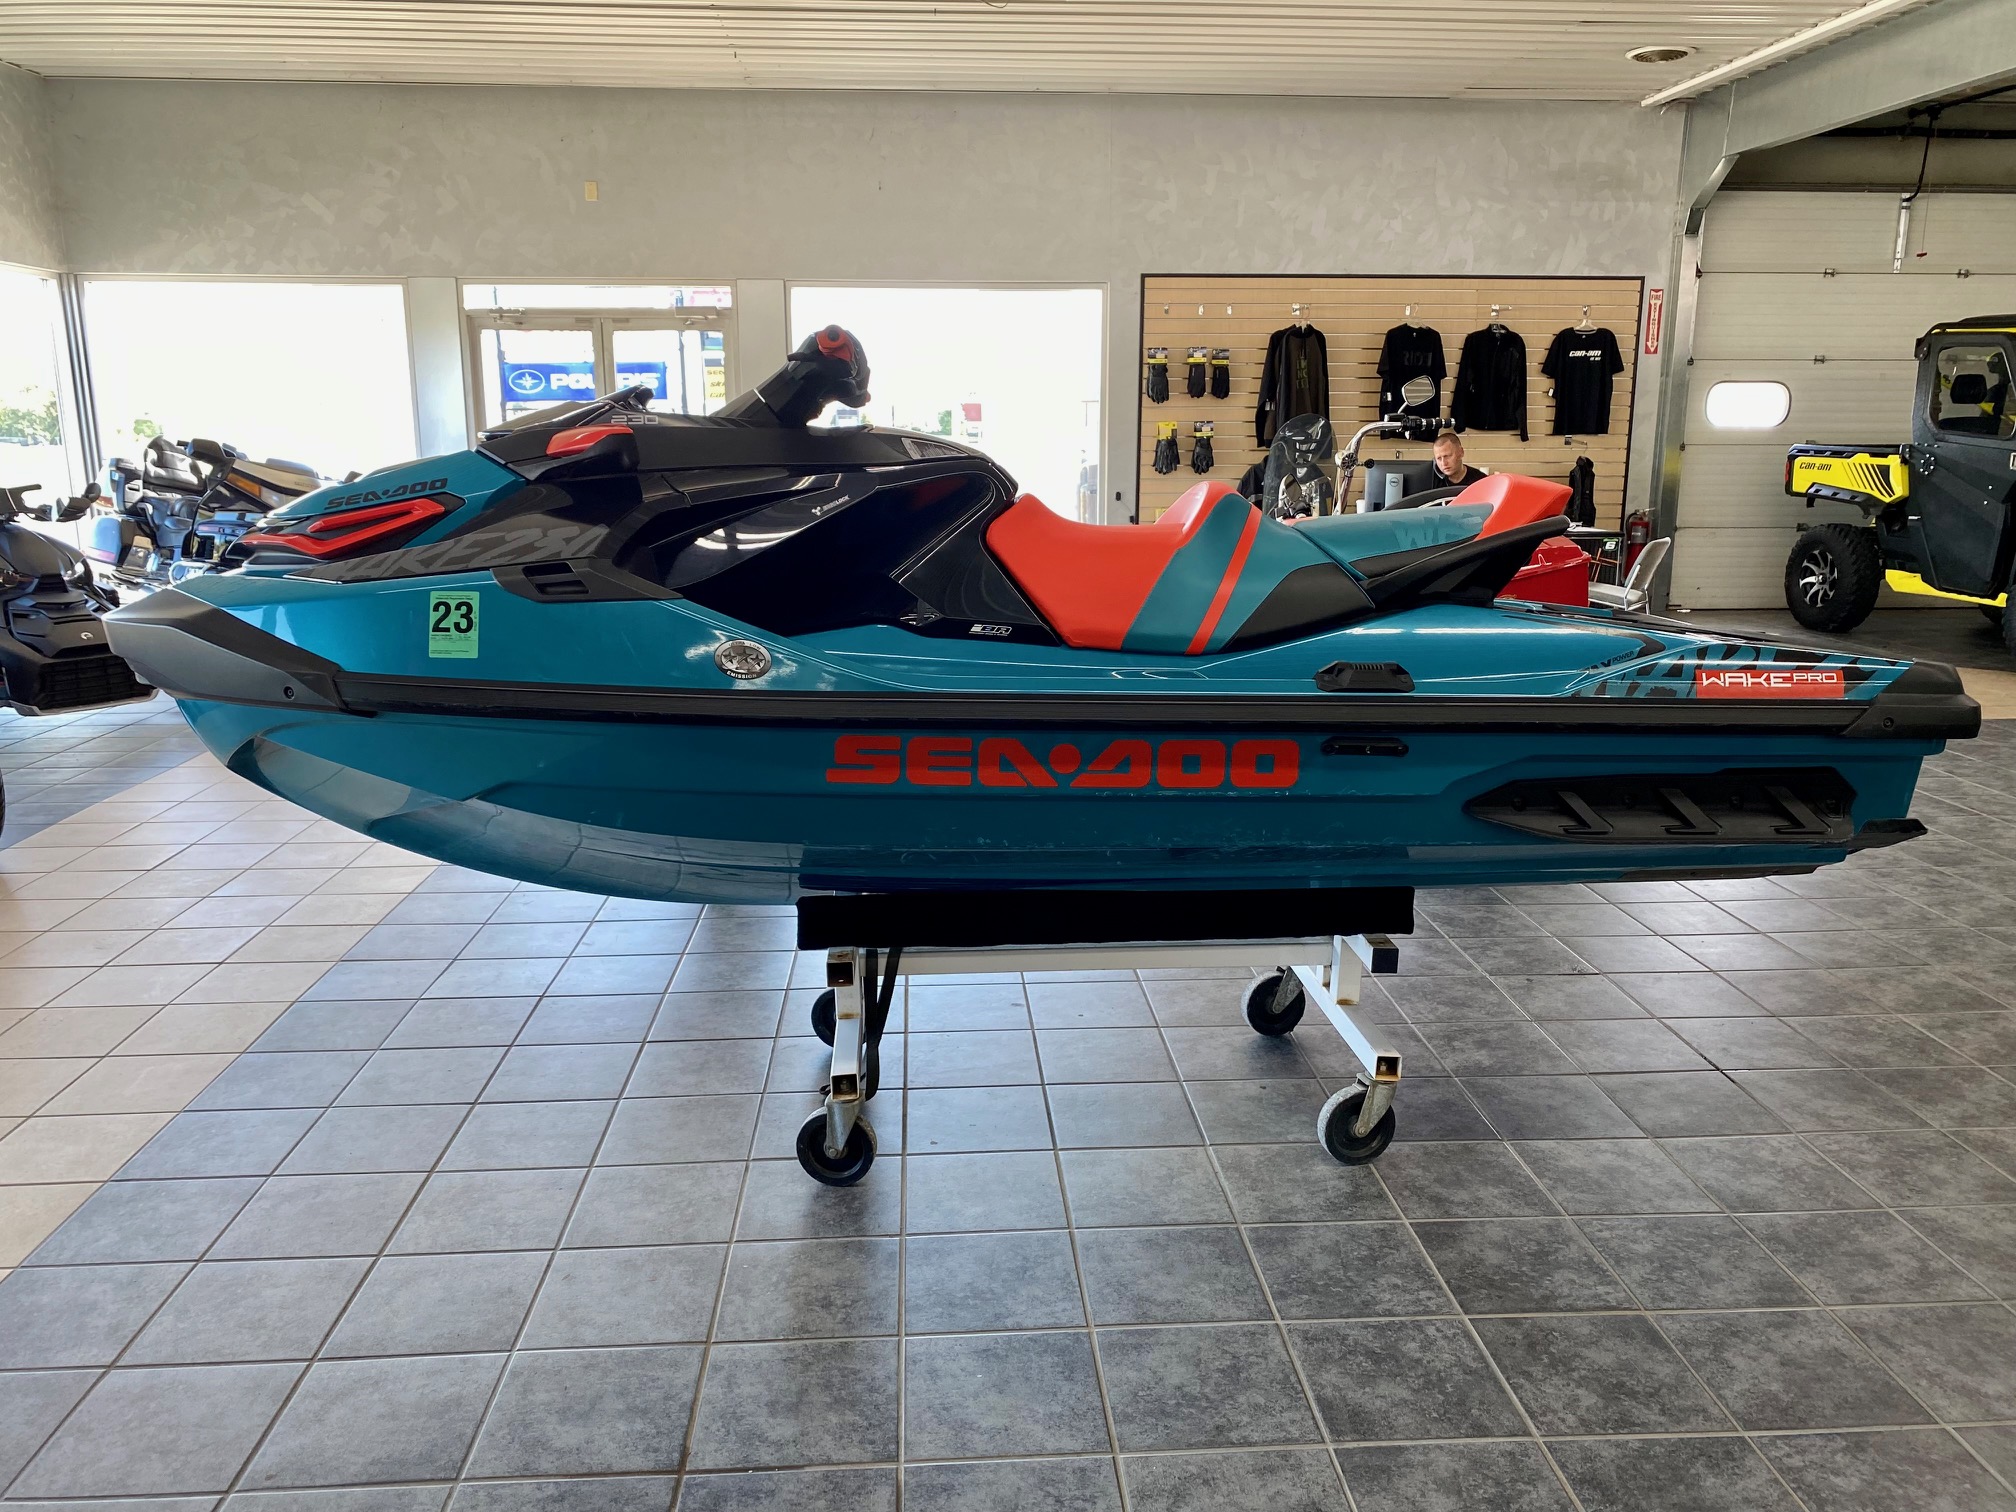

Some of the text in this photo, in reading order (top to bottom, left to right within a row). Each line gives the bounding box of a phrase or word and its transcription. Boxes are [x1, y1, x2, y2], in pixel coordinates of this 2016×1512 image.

[550, 372, 661, 391] POLRIS
[611, 415, 659, 425] 230
[1799, 462, 1832, 471] can-am
[431, 600, 474, 634] 23
[1702, 672, 1838, 688] WAKE PRO
